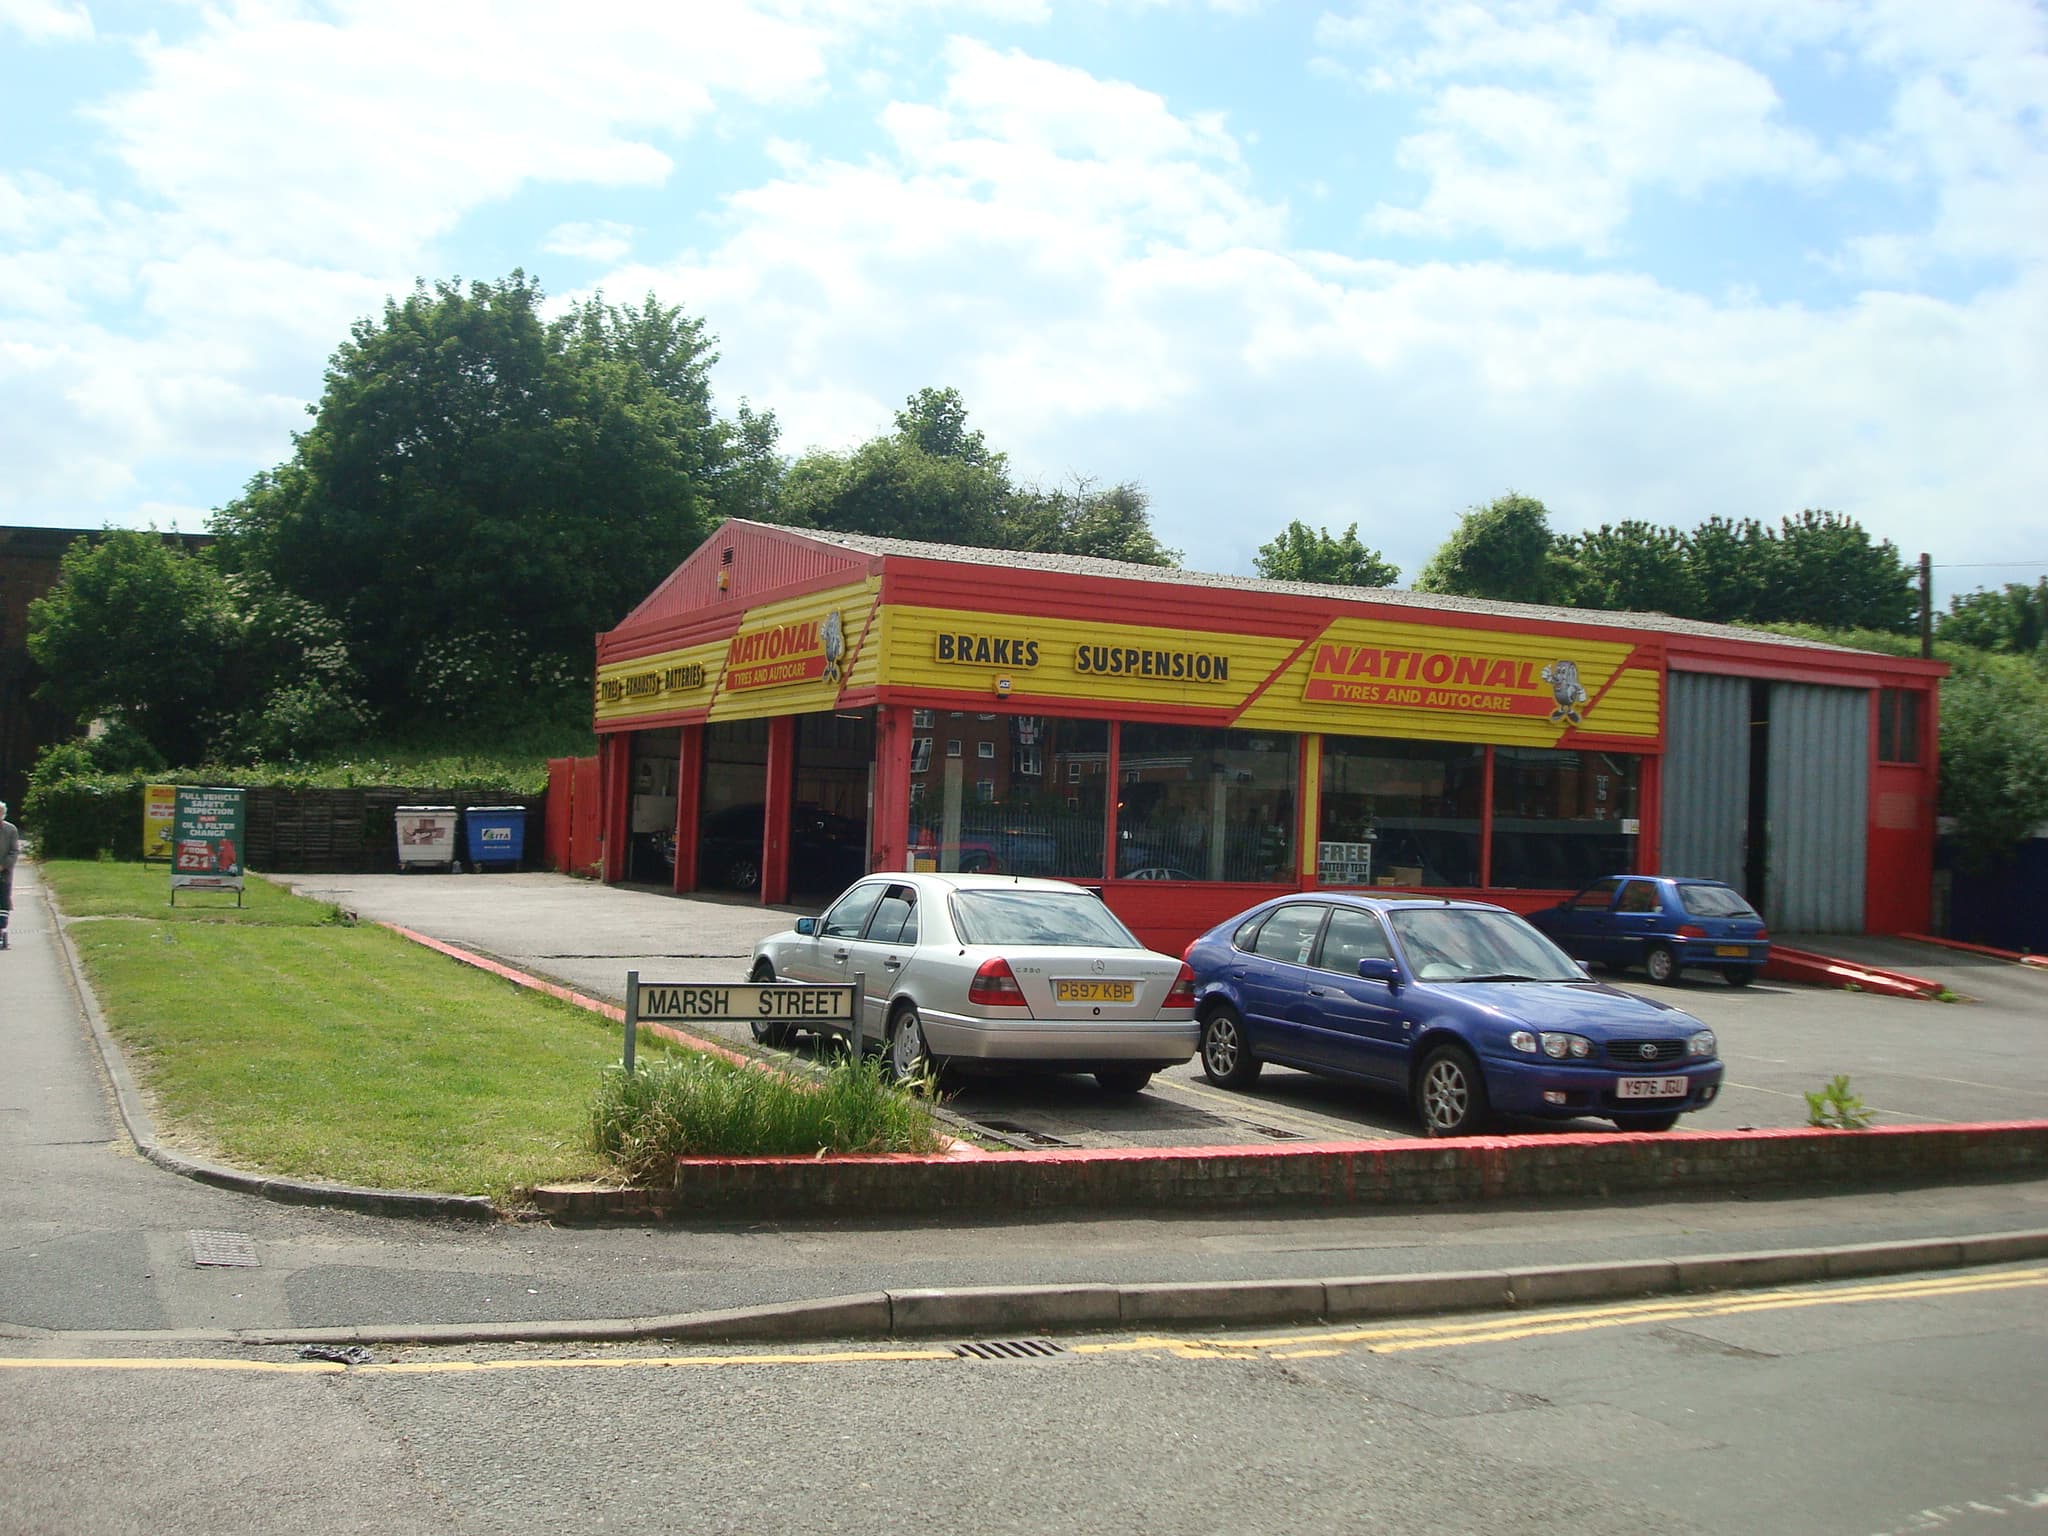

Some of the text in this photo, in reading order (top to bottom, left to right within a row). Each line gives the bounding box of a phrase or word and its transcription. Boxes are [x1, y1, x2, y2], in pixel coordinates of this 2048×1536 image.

[730, 621, 819, 666] NATIONAL
[938, 633, 1230, 682] BRAKES SUSPENSION
[1313, 643, 1539, 690] NATIONAL
[602, 663, 703, 699] TYRES EXHAUSTS BATTERIES
[735, 662, 807, 686] TYRES AND AUTOCARE
[1331, 683, 1512, 712] TYRES AND AUTOCARE
[191, 800, 226, 808] SAFETY
[203, 793, 240, 801] VEHICLE
[183, 807, 235, 815] INSPECTION
[189, 829, 226, 837] CHANGE
[1319, 844, 1369, 862] FREE
[1318, 862, 1368, 873] BATTERY TEST
[1060, 984, 1133, 998] P697 KBP
[647, 989, 843, 1015] MARSH STREET
[1625, 1079, 1658, 1095] Y976
